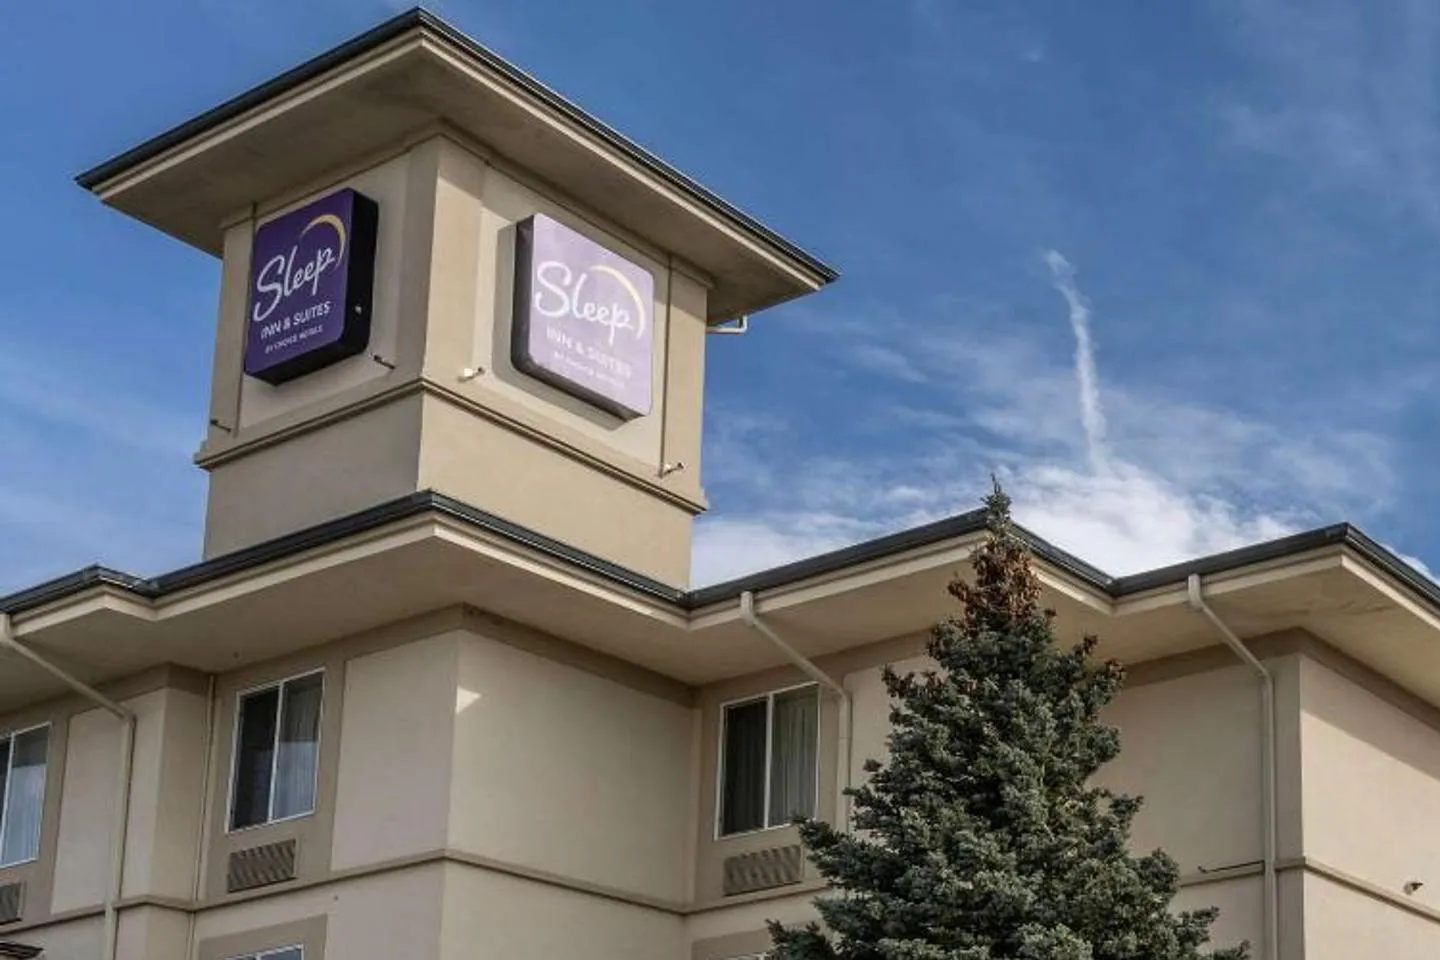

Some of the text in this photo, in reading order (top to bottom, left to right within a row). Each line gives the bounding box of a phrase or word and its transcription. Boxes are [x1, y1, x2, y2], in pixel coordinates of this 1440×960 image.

[253, 245, 336, 322] Sleep
[261, 319, 281, 340] INN
[293, 300, 332, 326] SUITES
[534, 260, 635, 346] Sleep
